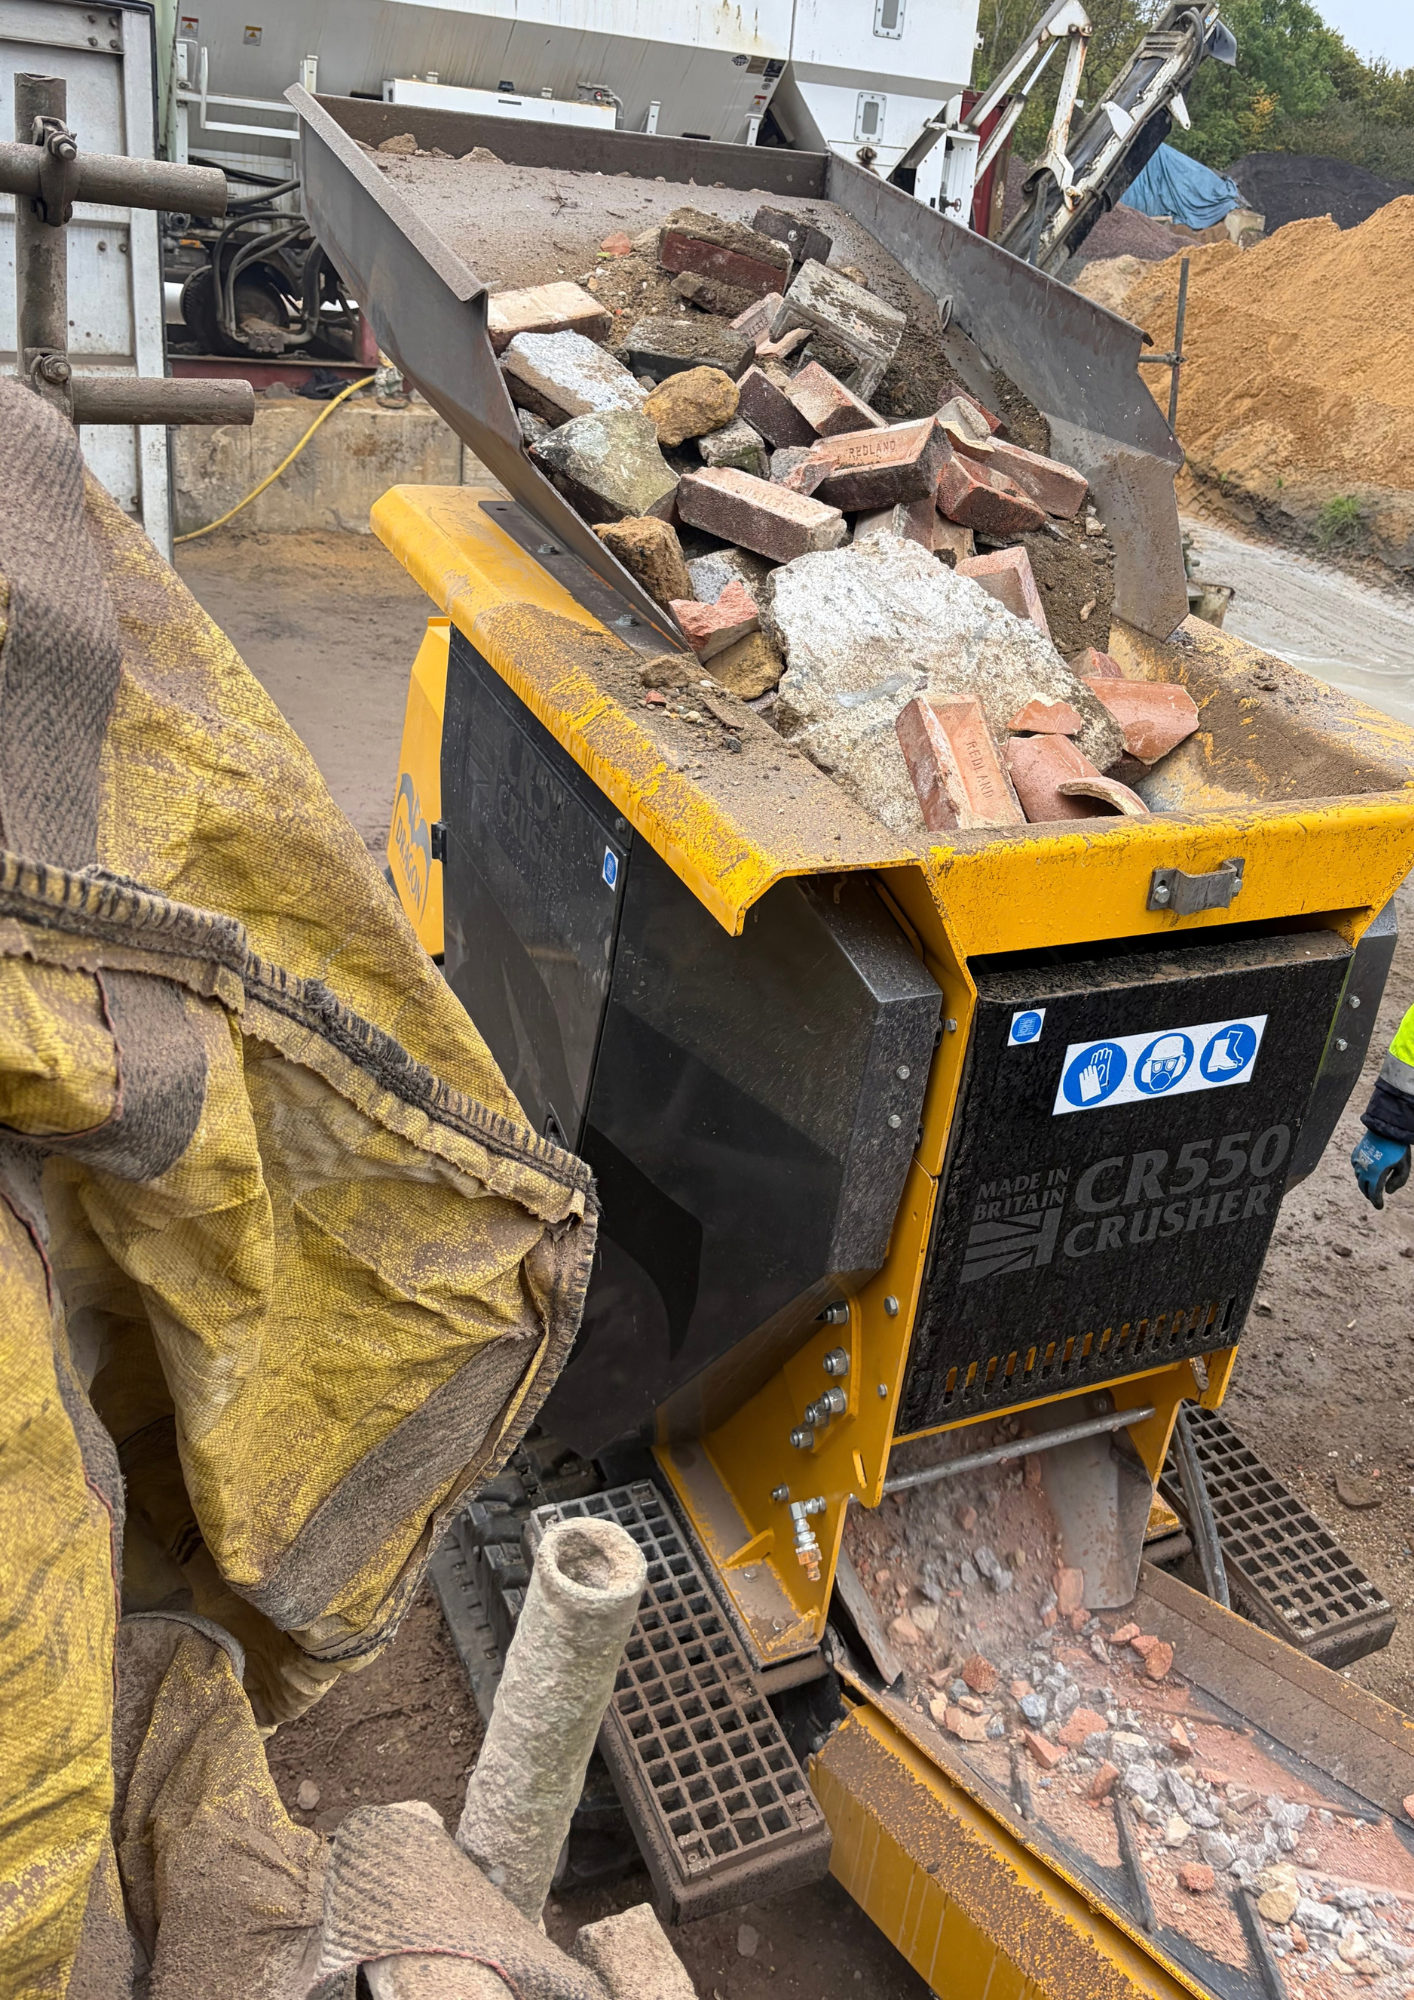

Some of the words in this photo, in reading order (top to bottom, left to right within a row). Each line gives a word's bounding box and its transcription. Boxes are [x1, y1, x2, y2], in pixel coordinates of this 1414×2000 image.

[848, 440, 896, 459] REDLAND
[966, 740, 994, 799] REDLAND
[395, 815, 422, 911] DRAGON
[976, 1172, 1041, 1201] MADE
[1046, 1167, 1071, 1186] IN
[1074, 1124, 1291, 1213] CR550
[972, 1187, 1067, 1222] BRITAIN
[1063, 1184, 1271, 1258] CRUSHER
